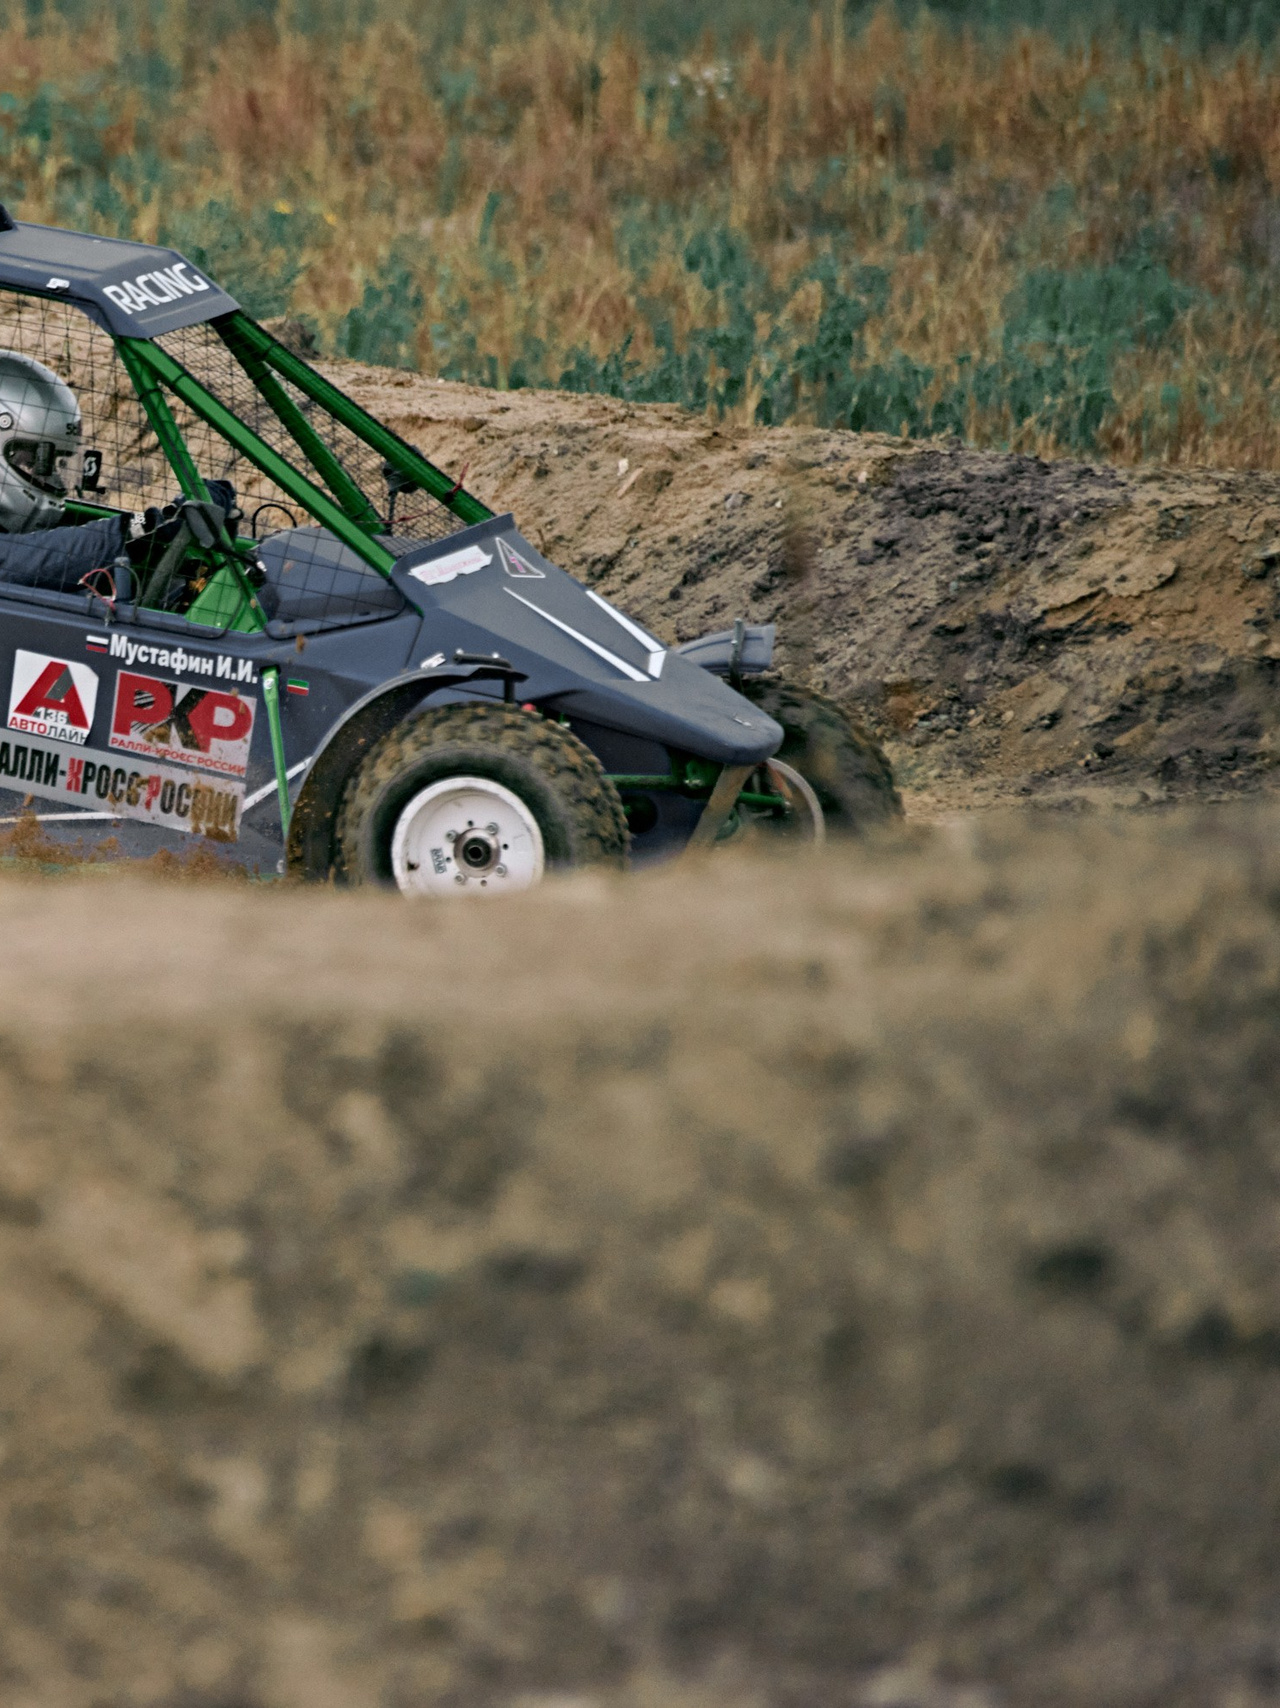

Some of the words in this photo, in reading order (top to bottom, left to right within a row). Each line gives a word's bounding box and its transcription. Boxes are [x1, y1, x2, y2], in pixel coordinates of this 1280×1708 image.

[102, 262, 210, 314] RACING
[110, 633, 215, 676] Мустафин
[216, 655, 258, 684] И.И.
[35, 706, 69, 725] 136
[196, 755, 246, 776] РОССИИ
